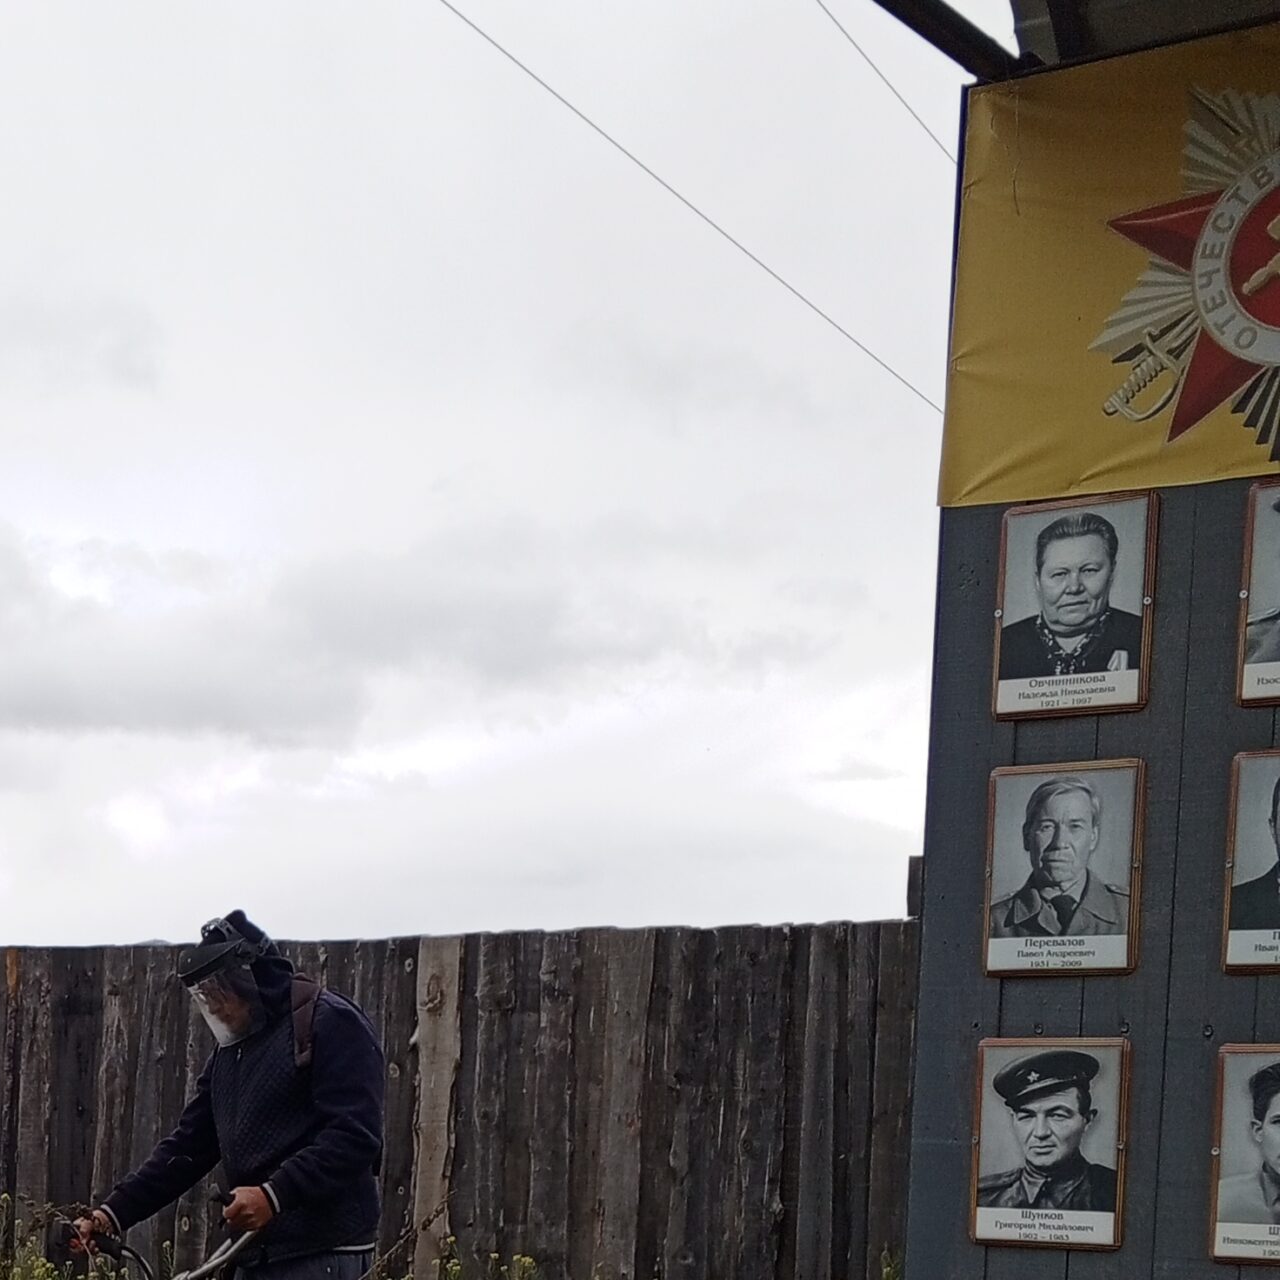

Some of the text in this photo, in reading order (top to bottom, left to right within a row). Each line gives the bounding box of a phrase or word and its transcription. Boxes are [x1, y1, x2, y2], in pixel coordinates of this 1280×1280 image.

[1028, 674, 1106, 688] Овчинникова
[1018, 685, 1116, 700] Надежда Николаевна
[1040, 699, 1060, 708] 1921
[1024, 938, 1085, 949] Перевалов
[1017, 949, 1096, 959] Павел Андреевич
[1020, 1210, 1064, 1221] Шунков
[994, 1220, 1094, 1232] Григорий Михайлович
[1268, 1226, 1280, 1236] Ш
